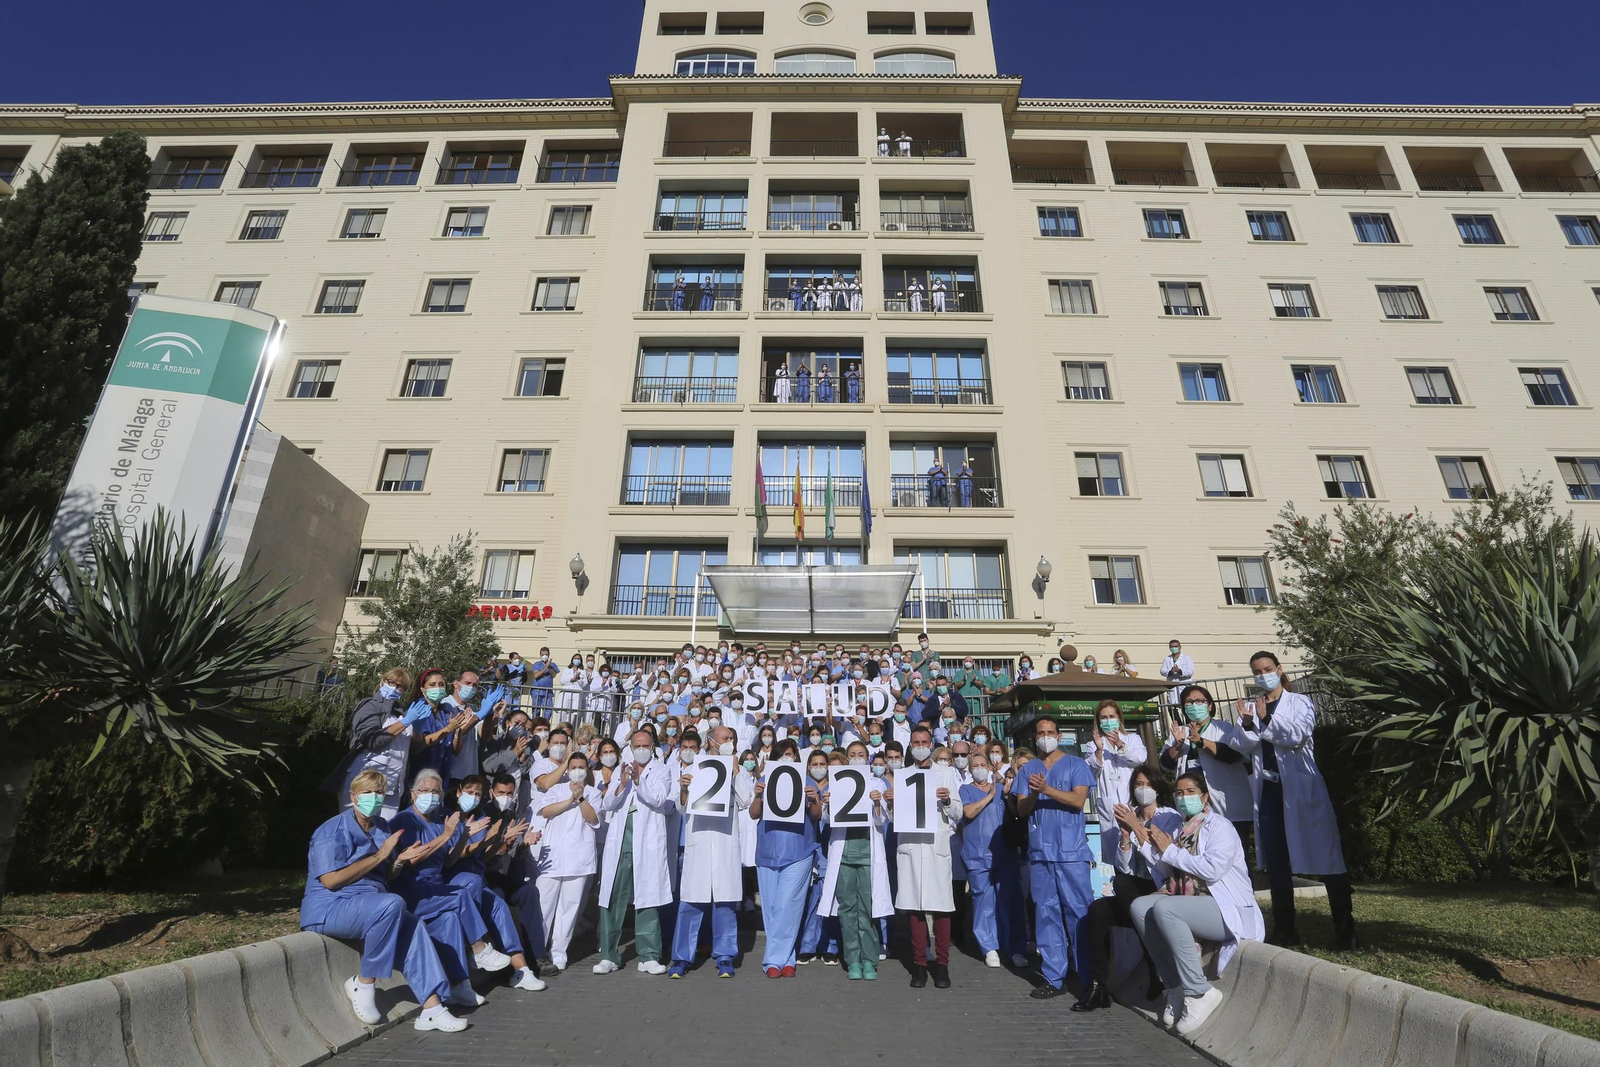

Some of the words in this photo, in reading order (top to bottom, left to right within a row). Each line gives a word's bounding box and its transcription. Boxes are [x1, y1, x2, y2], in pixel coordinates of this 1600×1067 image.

[127, 360, 149, 370] JUNTA
[152, 363, 161, 371] DE
[117, 398, 155, 453] Málaga
[110, 458, 132, 478] de
[113, 467, 155, 538] Hospital
[141, 398, 179, 461] General
[746, 682, 889, 716] SALUD
[691, 759, 925, 829] 2021
